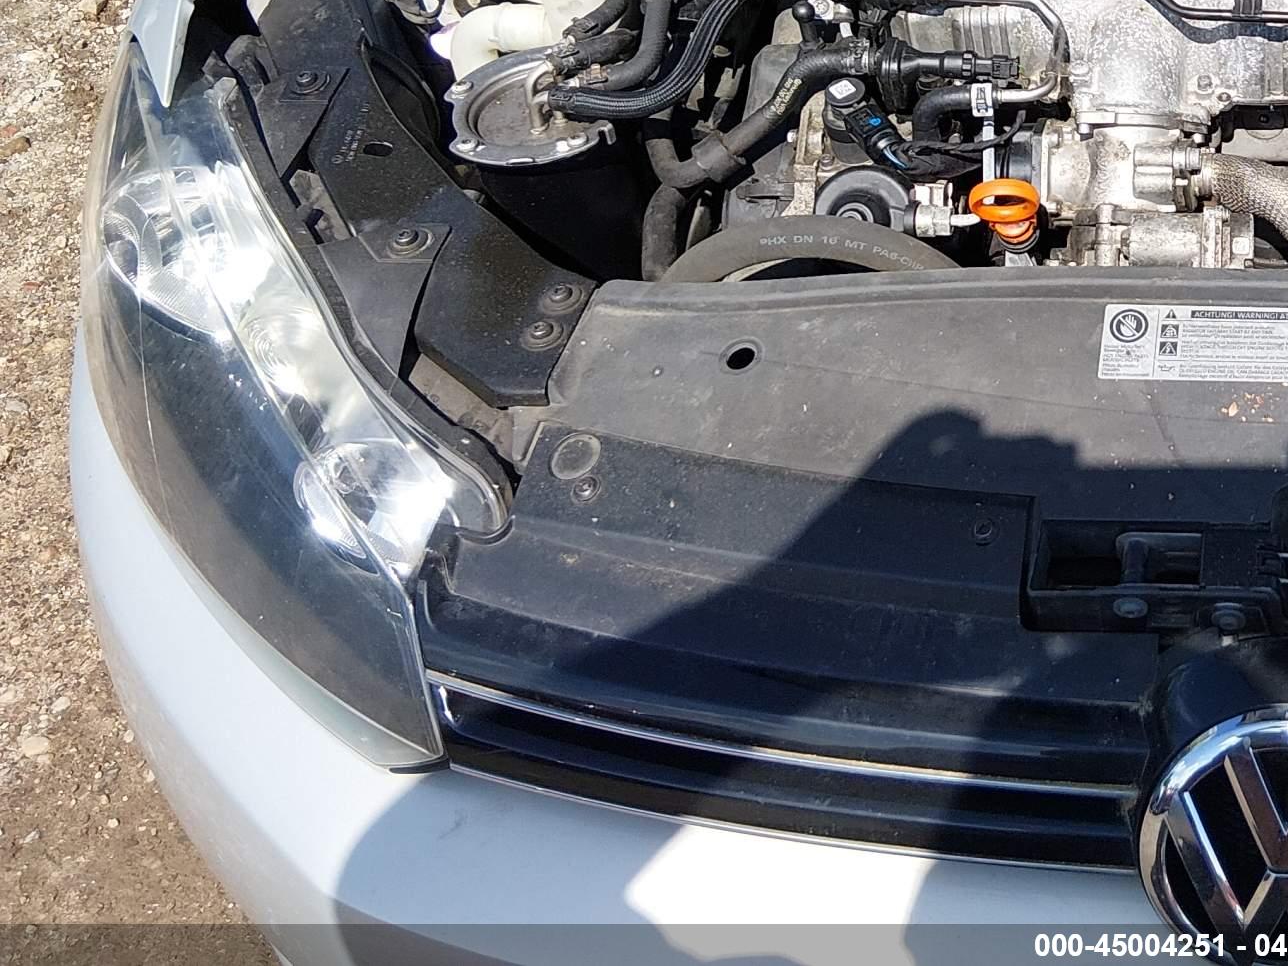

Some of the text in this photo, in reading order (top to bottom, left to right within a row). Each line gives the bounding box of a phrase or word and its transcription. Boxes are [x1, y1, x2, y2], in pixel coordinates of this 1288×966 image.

[793, 235, 814, 243] DN
[844, 239, 867, 250] MT
[1194, 311, 1236, 319] ACHTUNG!
[1237, 312, 1278, 320] WARNING!
